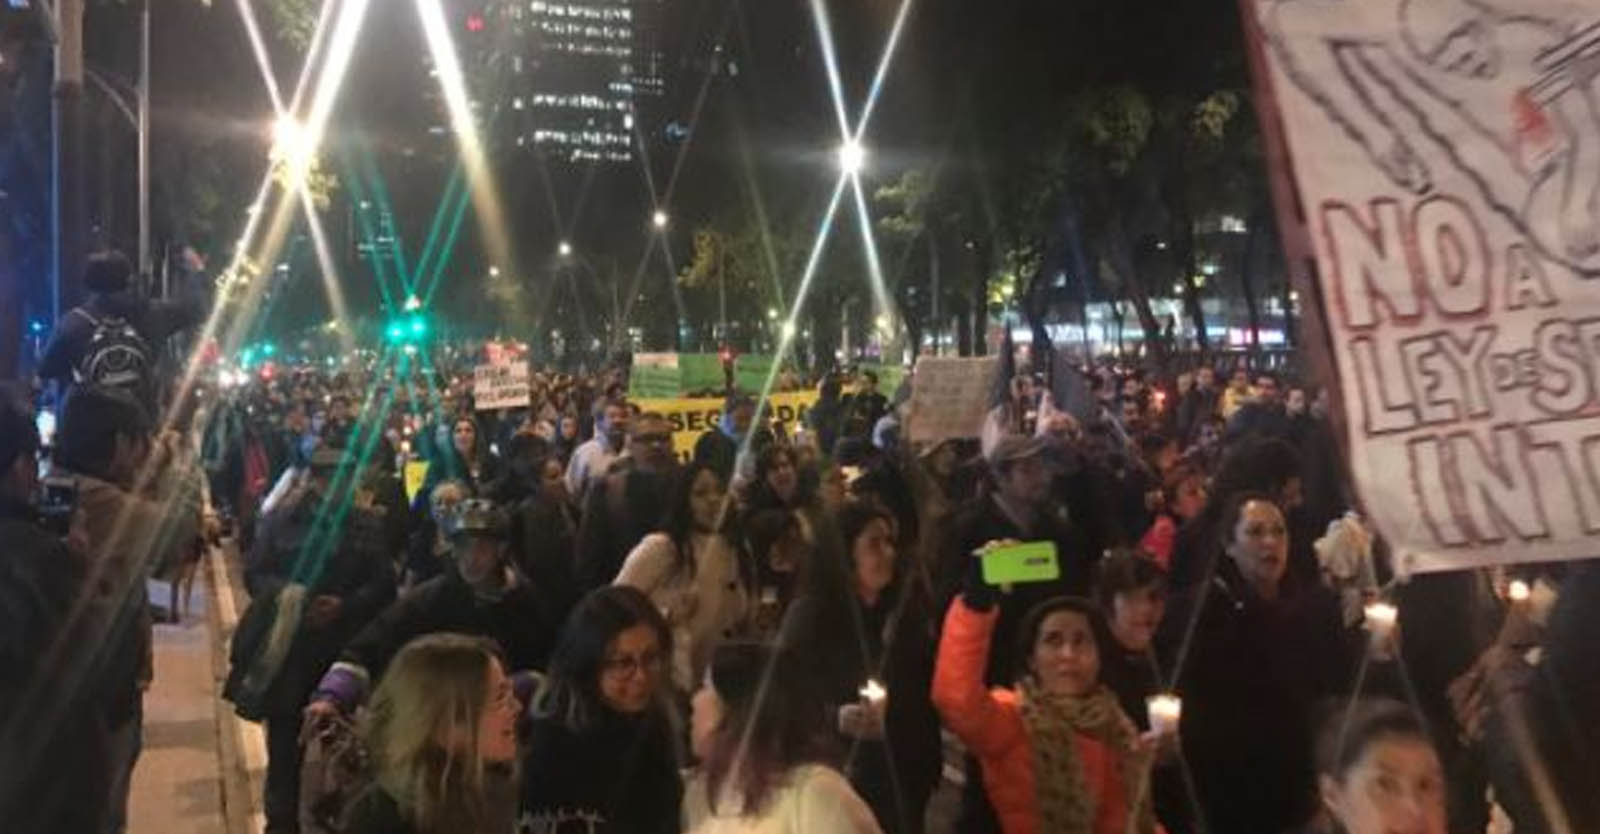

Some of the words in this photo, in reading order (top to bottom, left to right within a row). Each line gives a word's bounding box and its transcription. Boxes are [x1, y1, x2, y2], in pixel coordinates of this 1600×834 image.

[1320, 195, 1489, 330] NO
[1506, 243, 1557, 311] A
[1348, 325, 1497, 435] LEY
[1496, 348, 1538, 391] DE
